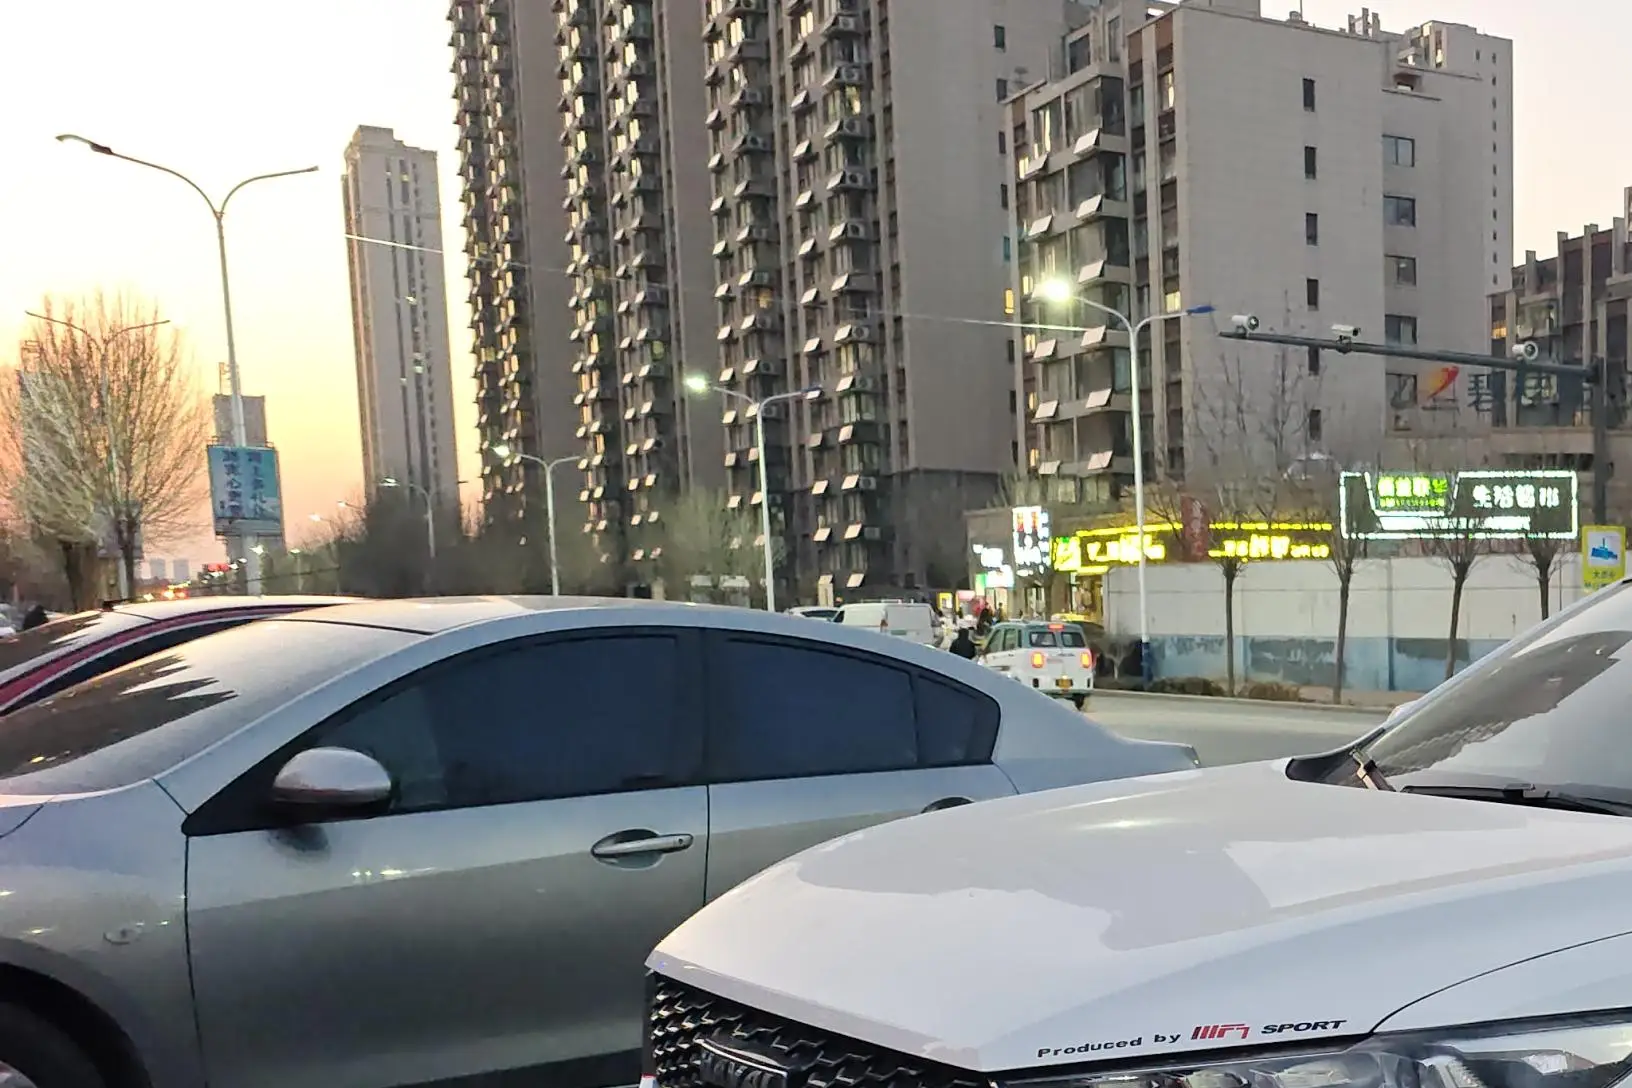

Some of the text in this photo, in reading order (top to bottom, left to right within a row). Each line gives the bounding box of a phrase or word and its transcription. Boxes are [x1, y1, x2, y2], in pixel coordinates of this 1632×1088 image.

[1037, 1037, 1142, 1058] Produced
[1154, 1032, 1181, 1045] by
[1260, 1019, 1348, 1036] SPORT
